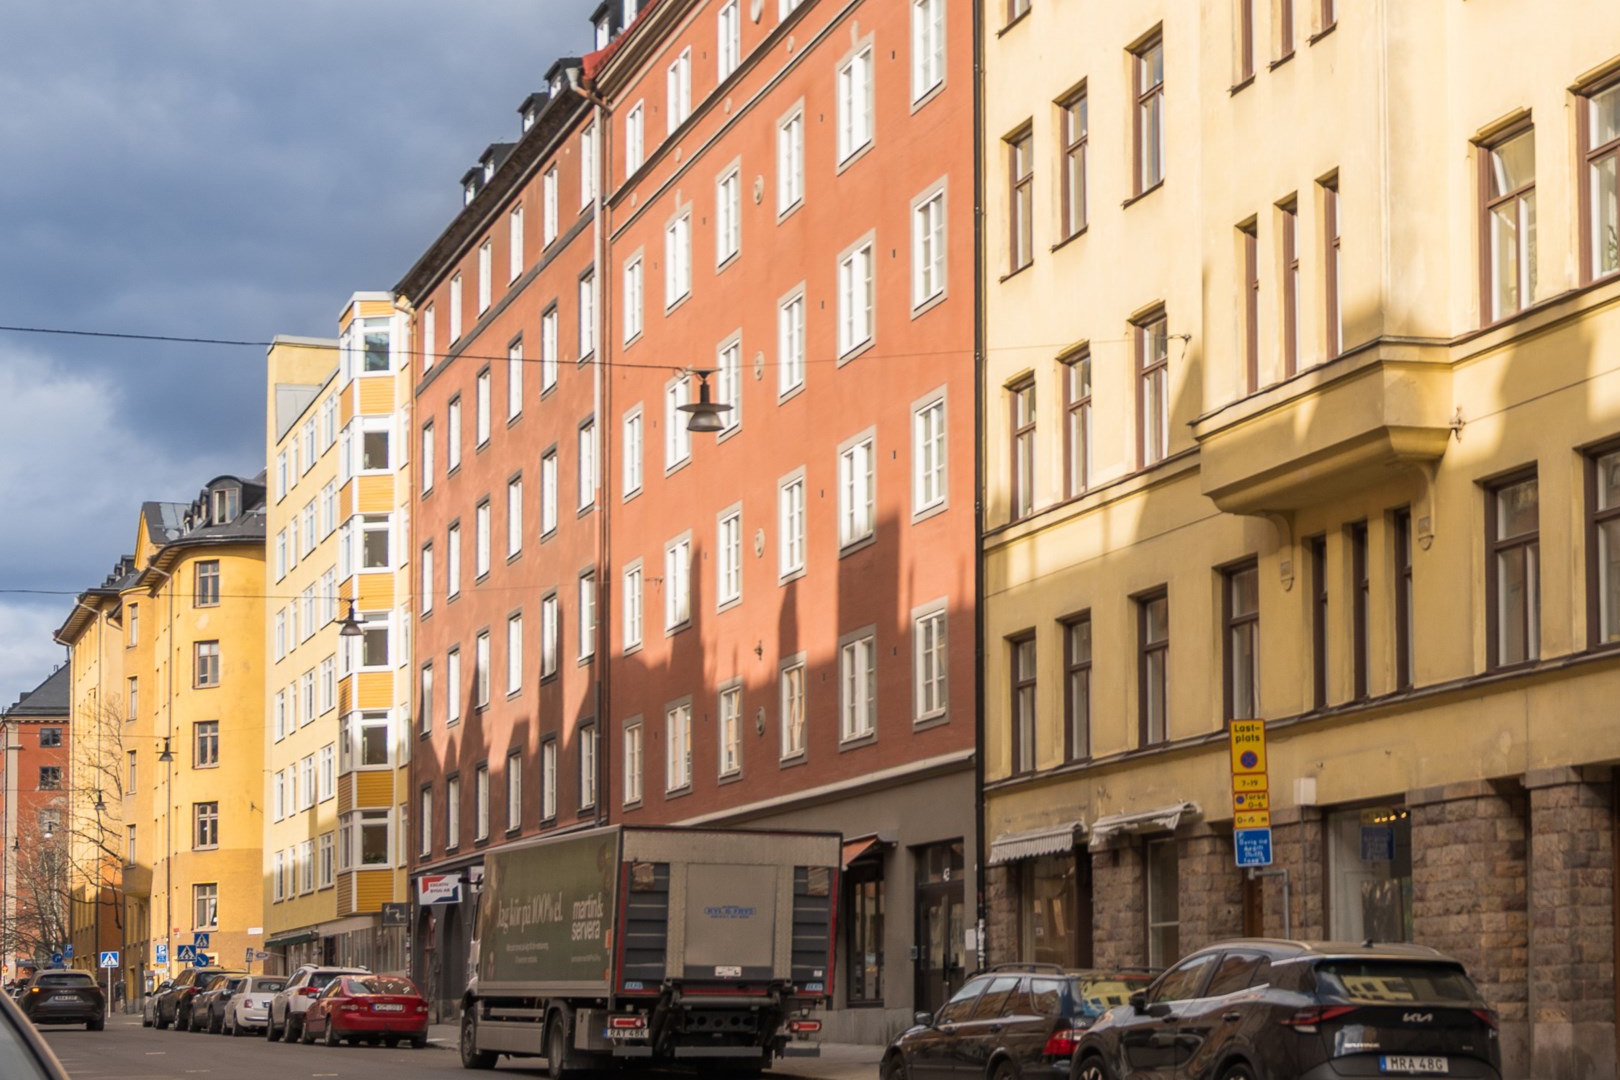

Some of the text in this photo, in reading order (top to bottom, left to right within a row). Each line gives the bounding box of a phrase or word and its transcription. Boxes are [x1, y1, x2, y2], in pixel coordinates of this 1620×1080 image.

[1234, 724, 1260, 732] Last-
[1235, 734, 1260, 744] plats
[572, 920, 601, 941] servera
[1402, 1012, 1434, 1022] KIA
[1390, 1057, 1443, 1070] MRA 48G
